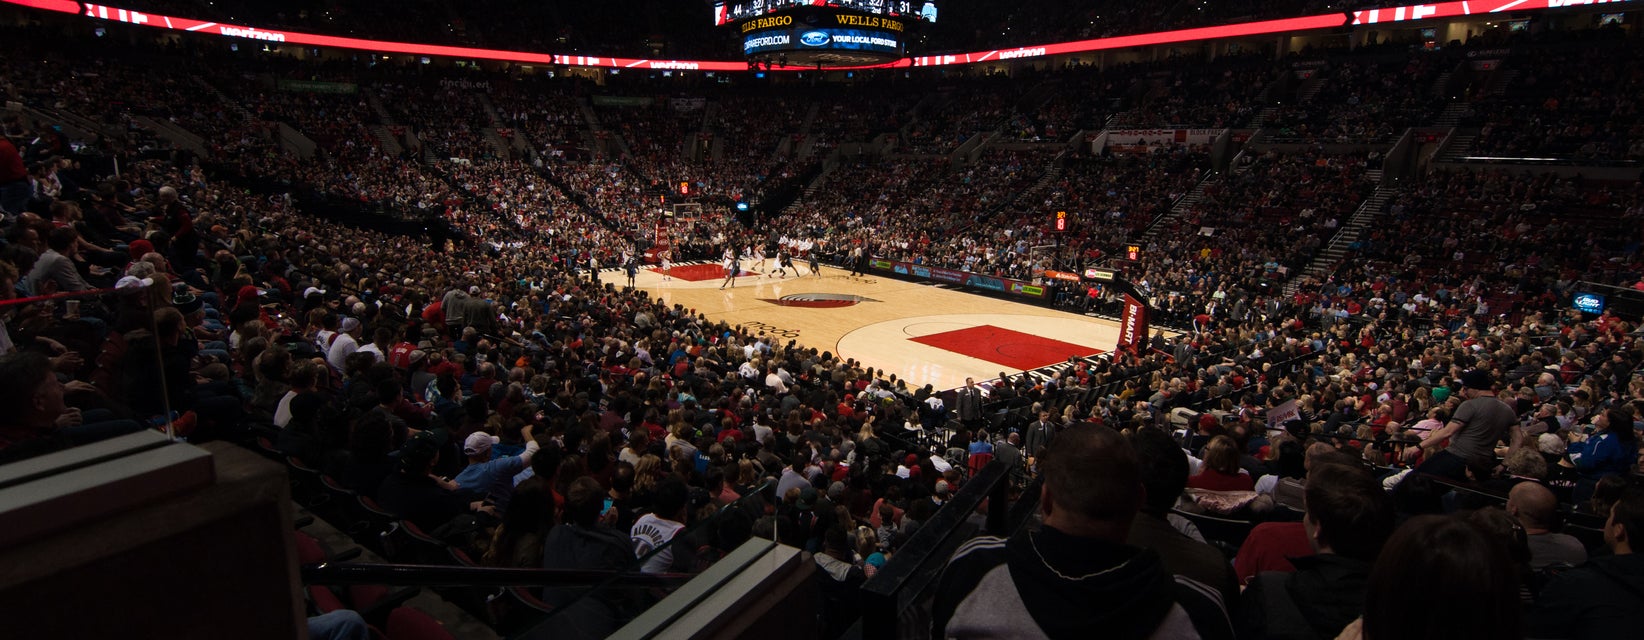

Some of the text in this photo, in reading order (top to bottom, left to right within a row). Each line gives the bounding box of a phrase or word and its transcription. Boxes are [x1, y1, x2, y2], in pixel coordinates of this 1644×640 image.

[733, 3, 742, 16] 44
[899, 1, 911, 14] 31
[741, 15, 792, 33] ELLS FARGO
[836, 14, 904, 32] WELLS FARGO
[220, 27, 285, 42] verizon
[832, 35, 851, 43] YOUR
[851, 36, 870, 44] LOCAL
[870, 37, 884, 46] FORD
[999, 48, 1046, 60] verizon
[650, 60, 699, 70] verizon
